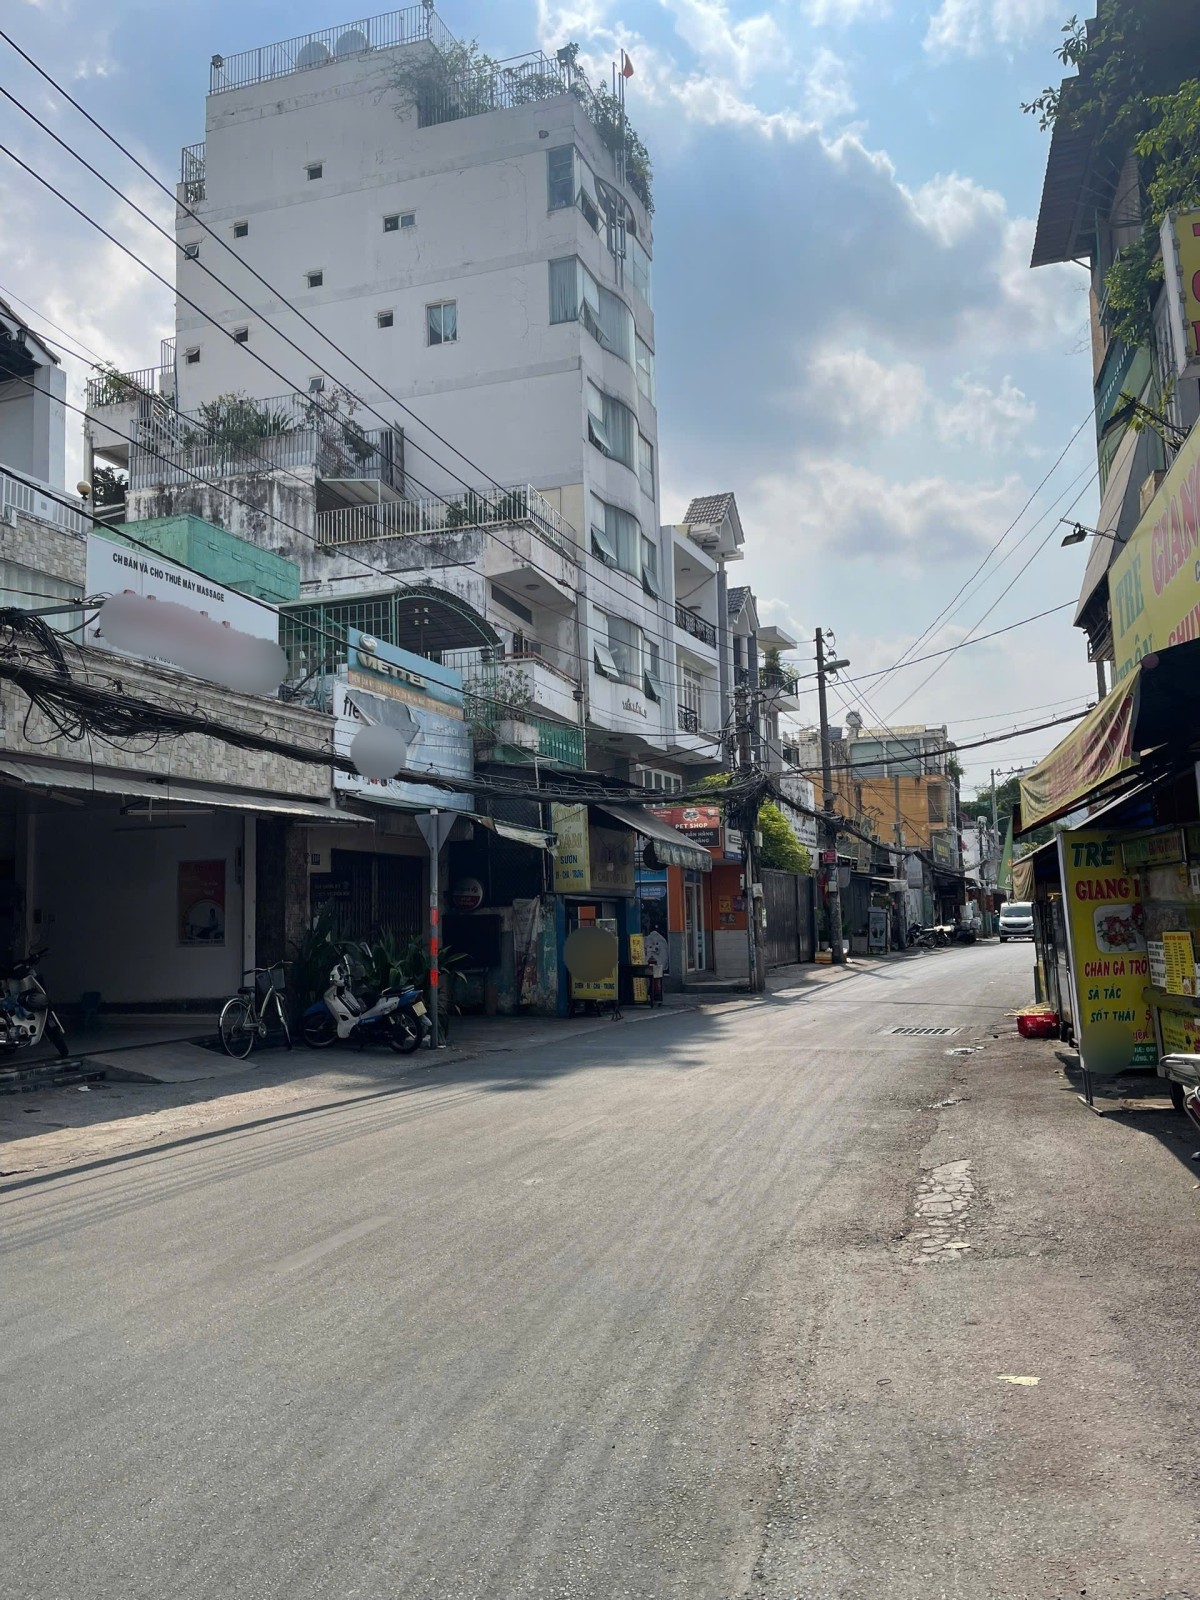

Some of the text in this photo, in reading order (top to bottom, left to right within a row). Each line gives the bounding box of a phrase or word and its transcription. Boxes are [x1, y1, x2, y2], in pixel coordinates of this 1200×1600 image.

[112, 553, 123, 565] CH
[123, 557, 139, 570] BÁN
[139, 562, 149, 574] VÀ
[149, 567, 164, 580] CHO
[196, 585, 225, 602] MASSAGE
[1076, 878, 1131, 901] GIANG
[1085, 958, 1110, 977] CHÂN
[1113, 957, 1126, 975] GÀ
[1088, 984, 1100, 1000] SẢ
[1113, 1007, 1135, 1021] THÁI
